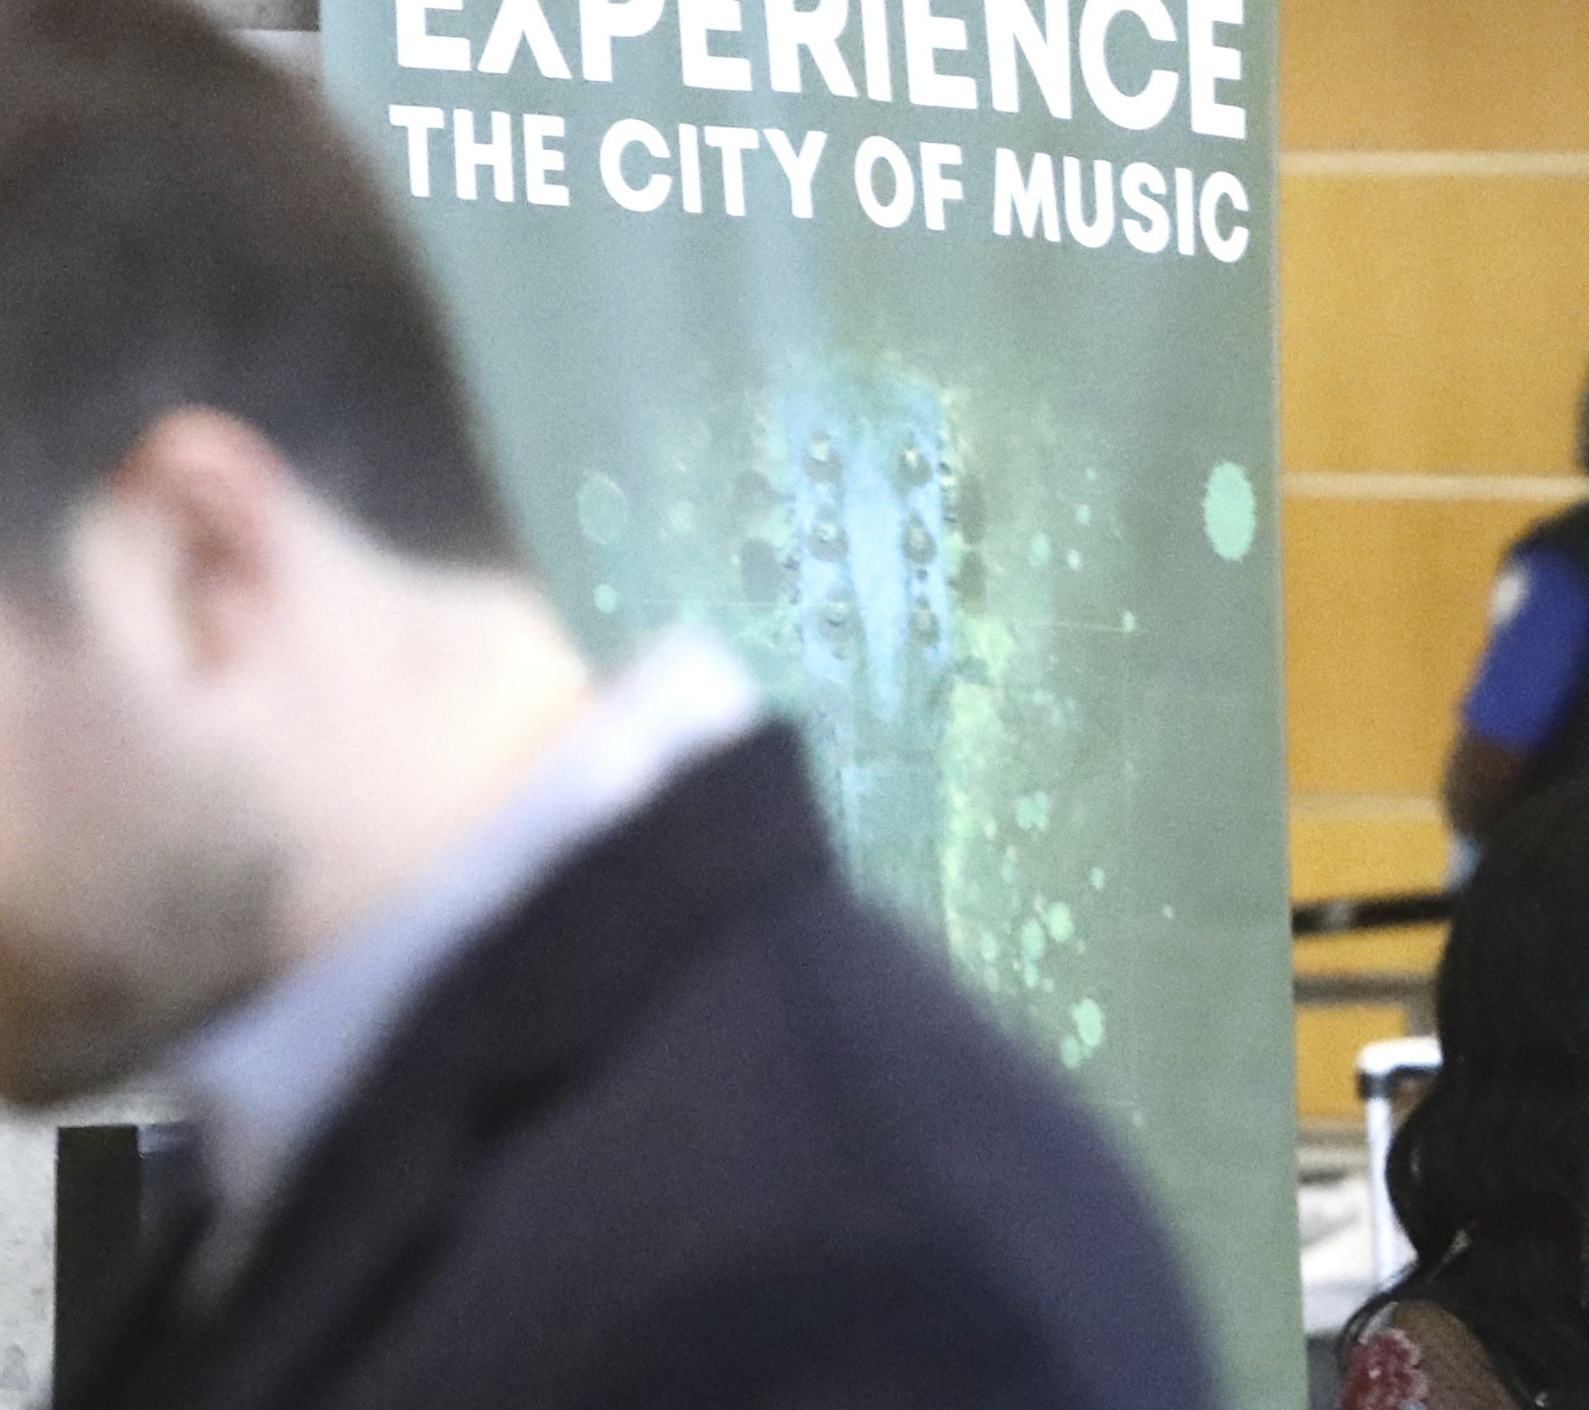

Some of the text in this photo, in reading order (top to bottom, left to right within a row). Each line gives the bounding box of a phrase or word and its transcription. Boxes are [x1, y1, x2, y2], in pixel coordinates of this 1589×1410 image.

[396, 0, 1246, 139] EXPERIENCE
[388, 103, 1250, 263] THE CITY OF MUSIC
